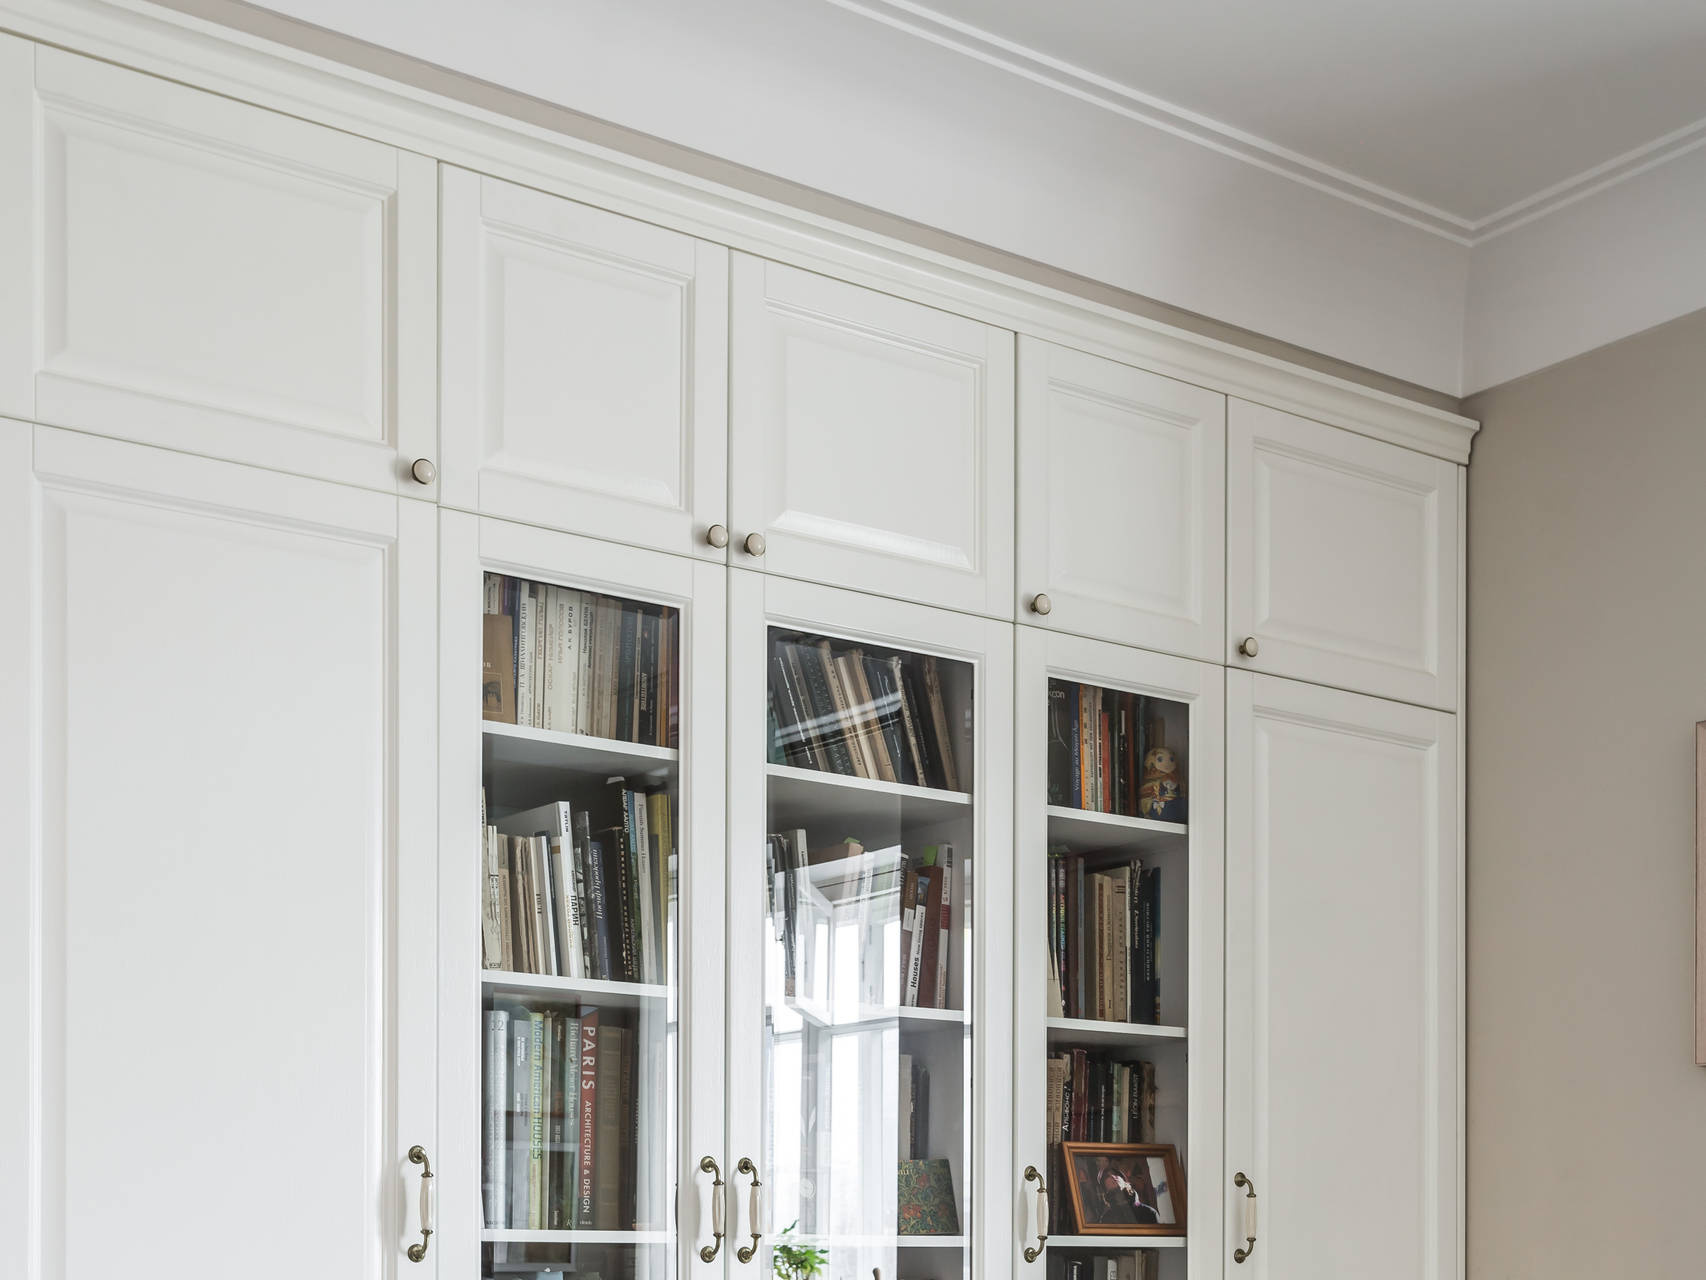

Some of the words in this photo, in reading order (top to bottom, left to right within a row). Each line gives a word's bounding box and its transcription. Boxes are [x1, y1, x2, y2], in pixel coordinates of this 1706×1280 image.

[569, 895, 580, 926] ПАРИН
[910, 956, 921, 989] Houses
[534, 1019, 544, 1061] Modern
[581, 1025, 596, 1091] PARIS
[532, 1116, 543, 1160] HOUSES
[583, 1099, 592, 1167] ARCHITECTURE
[583, 1177, 592, 1214] DESIGN
